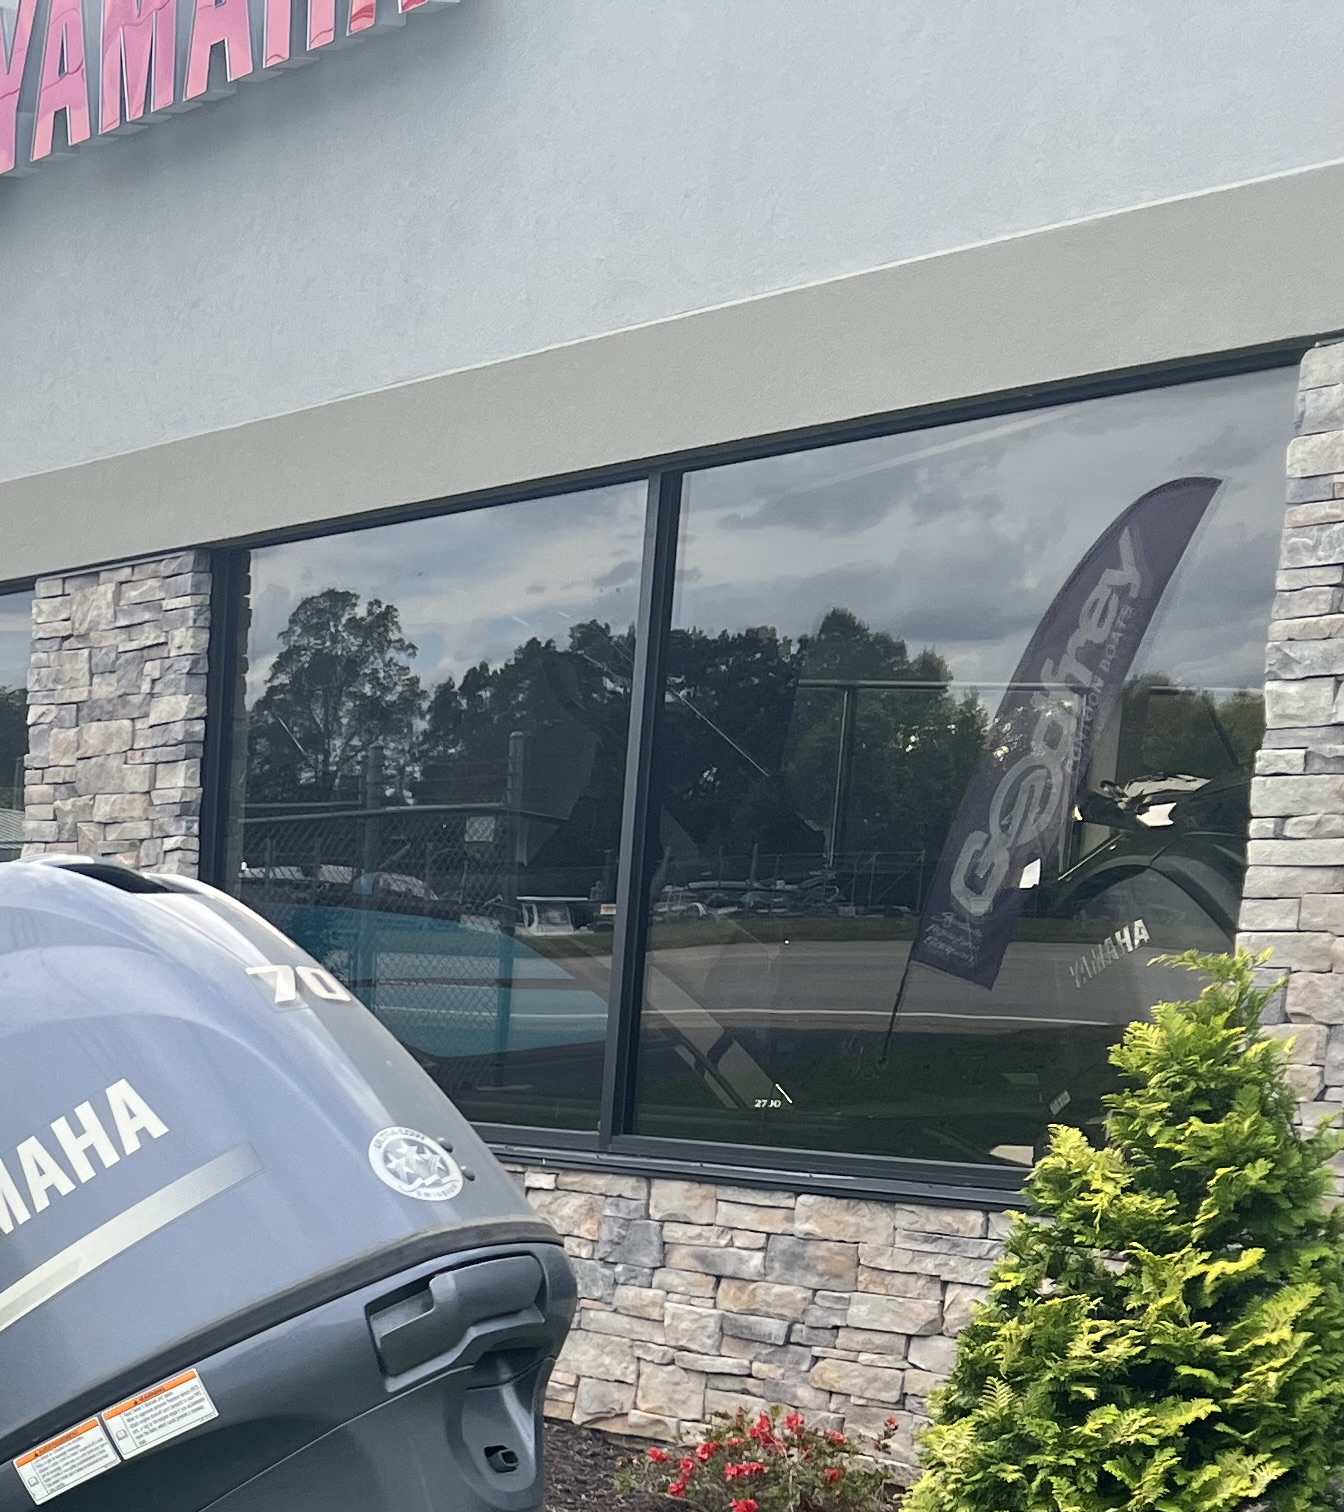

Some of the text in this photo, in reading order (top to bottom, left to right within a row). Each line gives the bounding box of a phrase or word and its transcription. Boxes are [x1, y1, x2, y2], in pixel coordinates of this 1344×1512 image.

[950, 525, 1141, 918] Godfrey
[245, 965, 351, 1002] 70
[1069, 919, 1151, 989] YAMAHA
